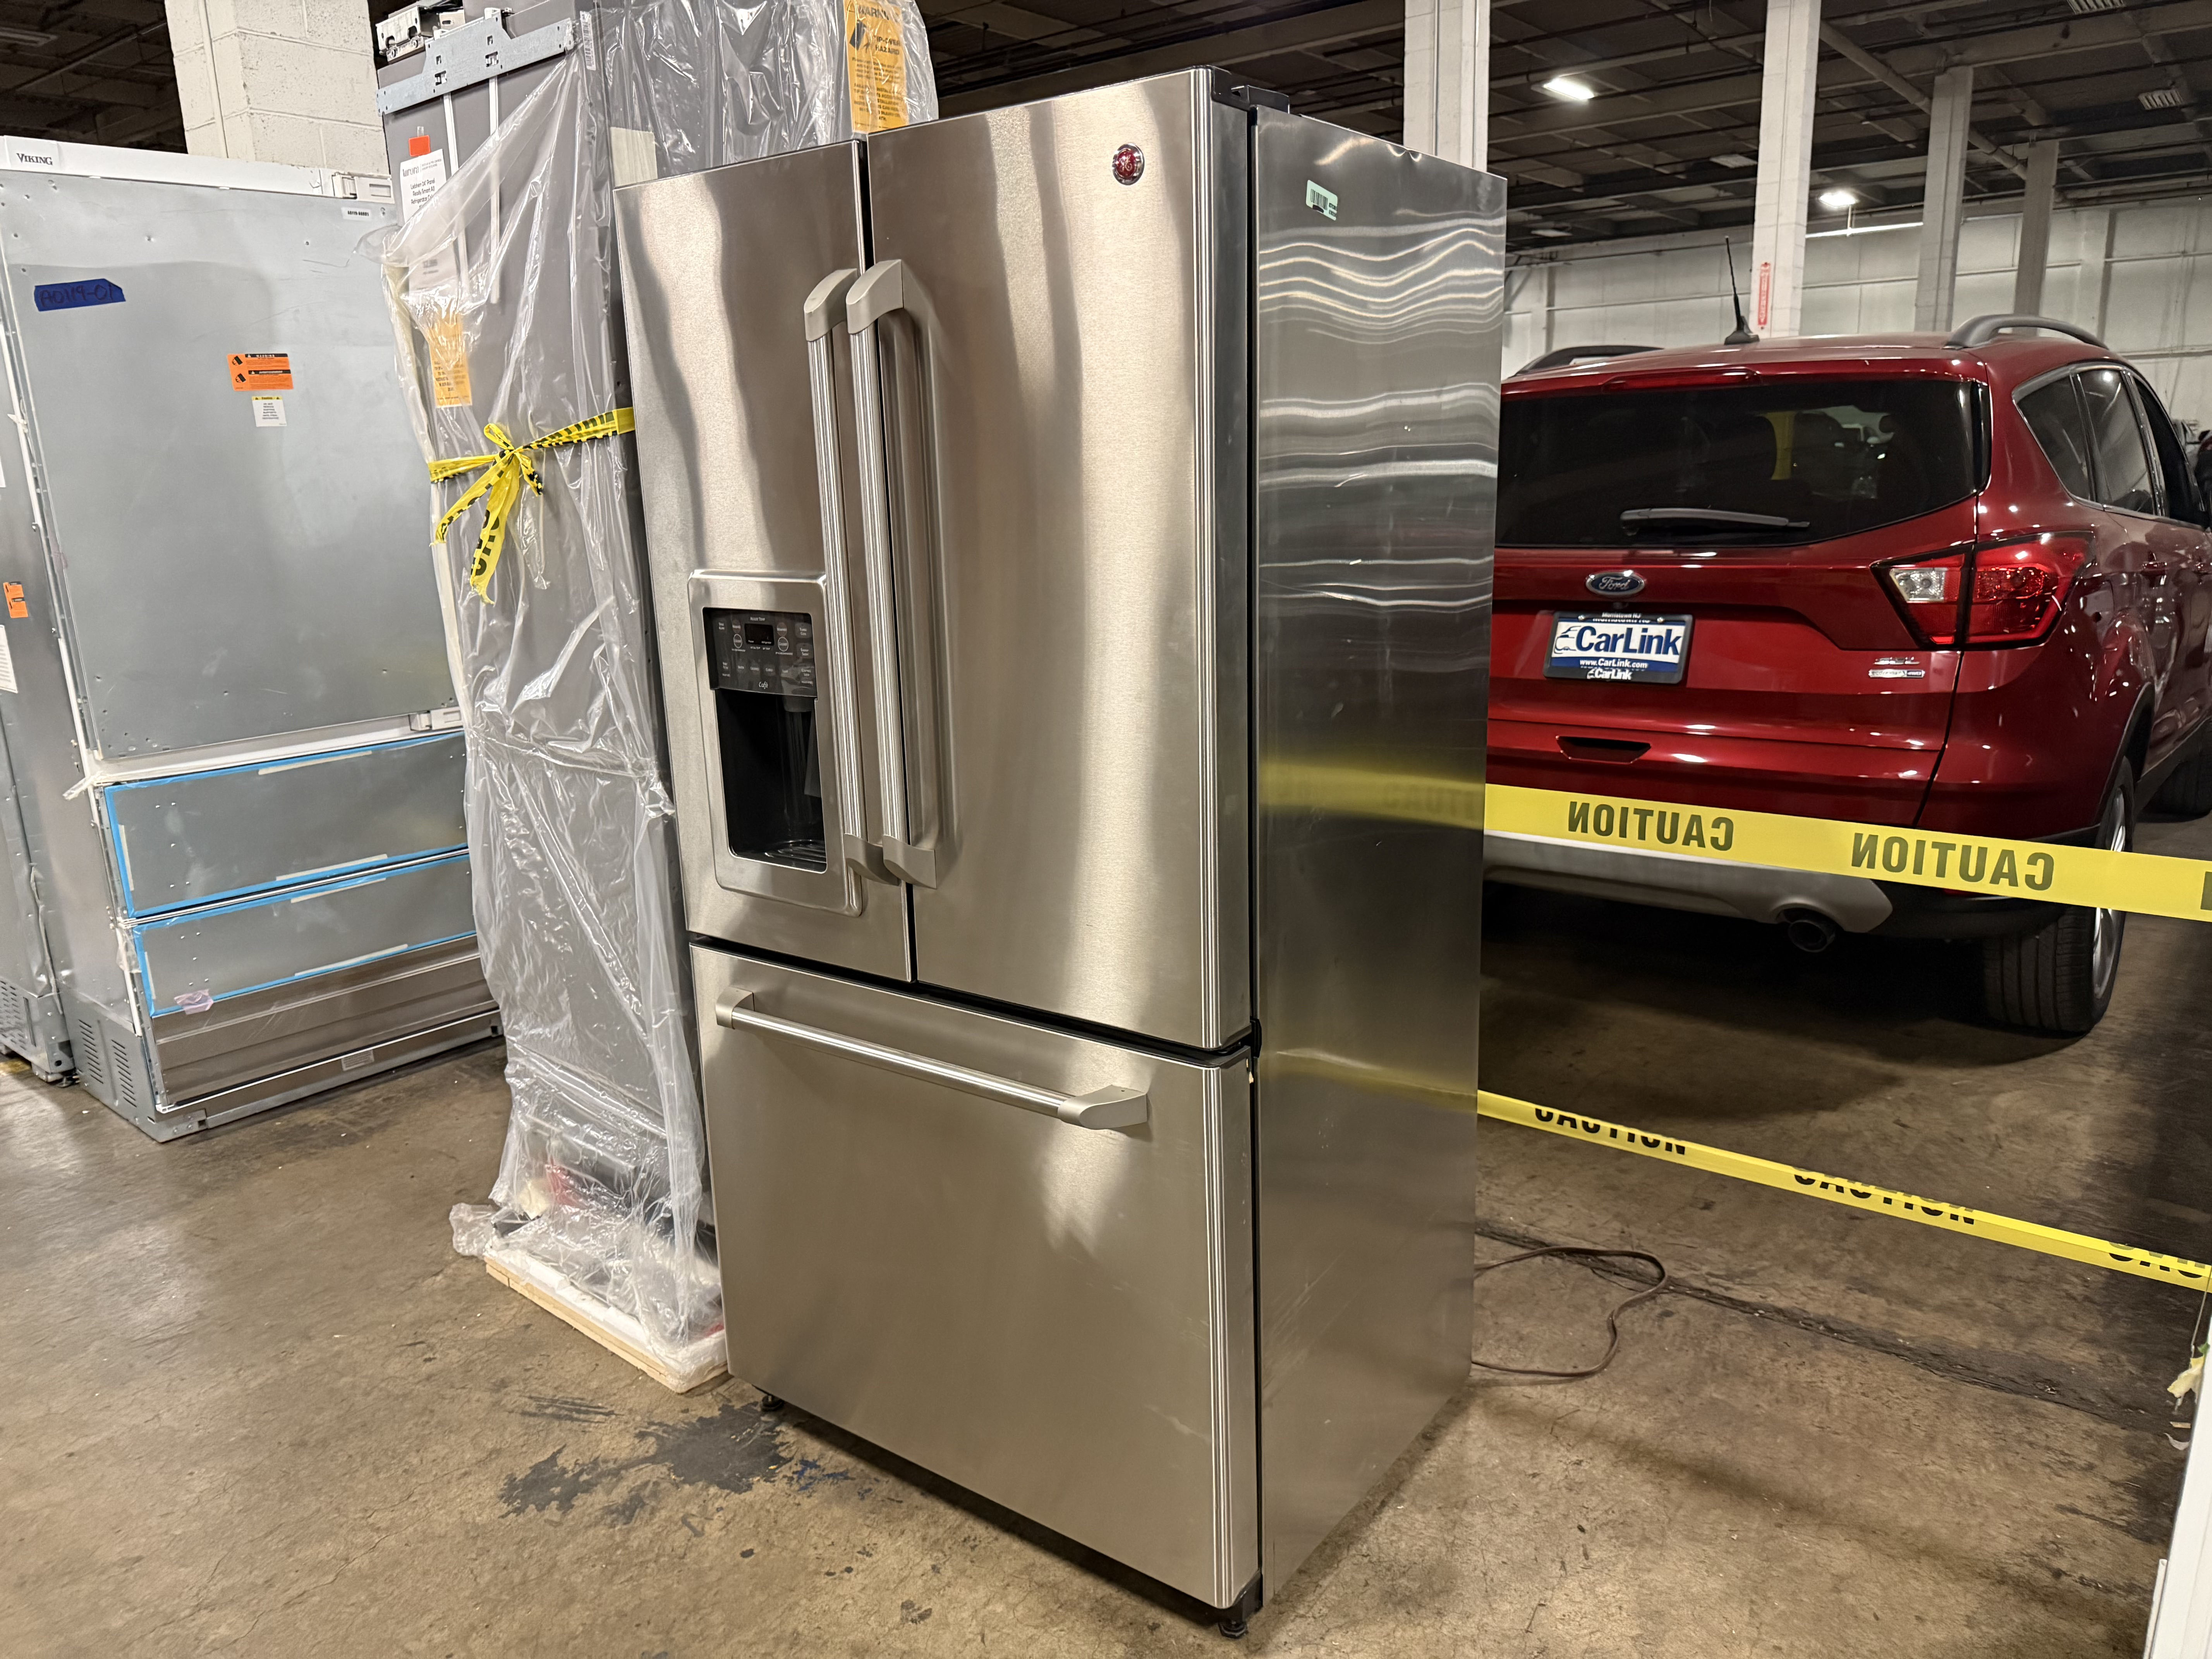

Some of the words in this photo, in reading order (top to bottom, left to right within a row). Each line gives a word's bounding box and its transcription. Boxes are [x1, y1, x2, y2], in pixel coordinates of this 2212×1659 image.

[16, 153, 53, 166] VIKING
[1598, 576, 1632, 590] Ford
[1575, 626, 1683, 655] CarLink
[1579, 658, 1649, 669] www.CarLink.com
[1594, 668, 1632, 680] CarLink
